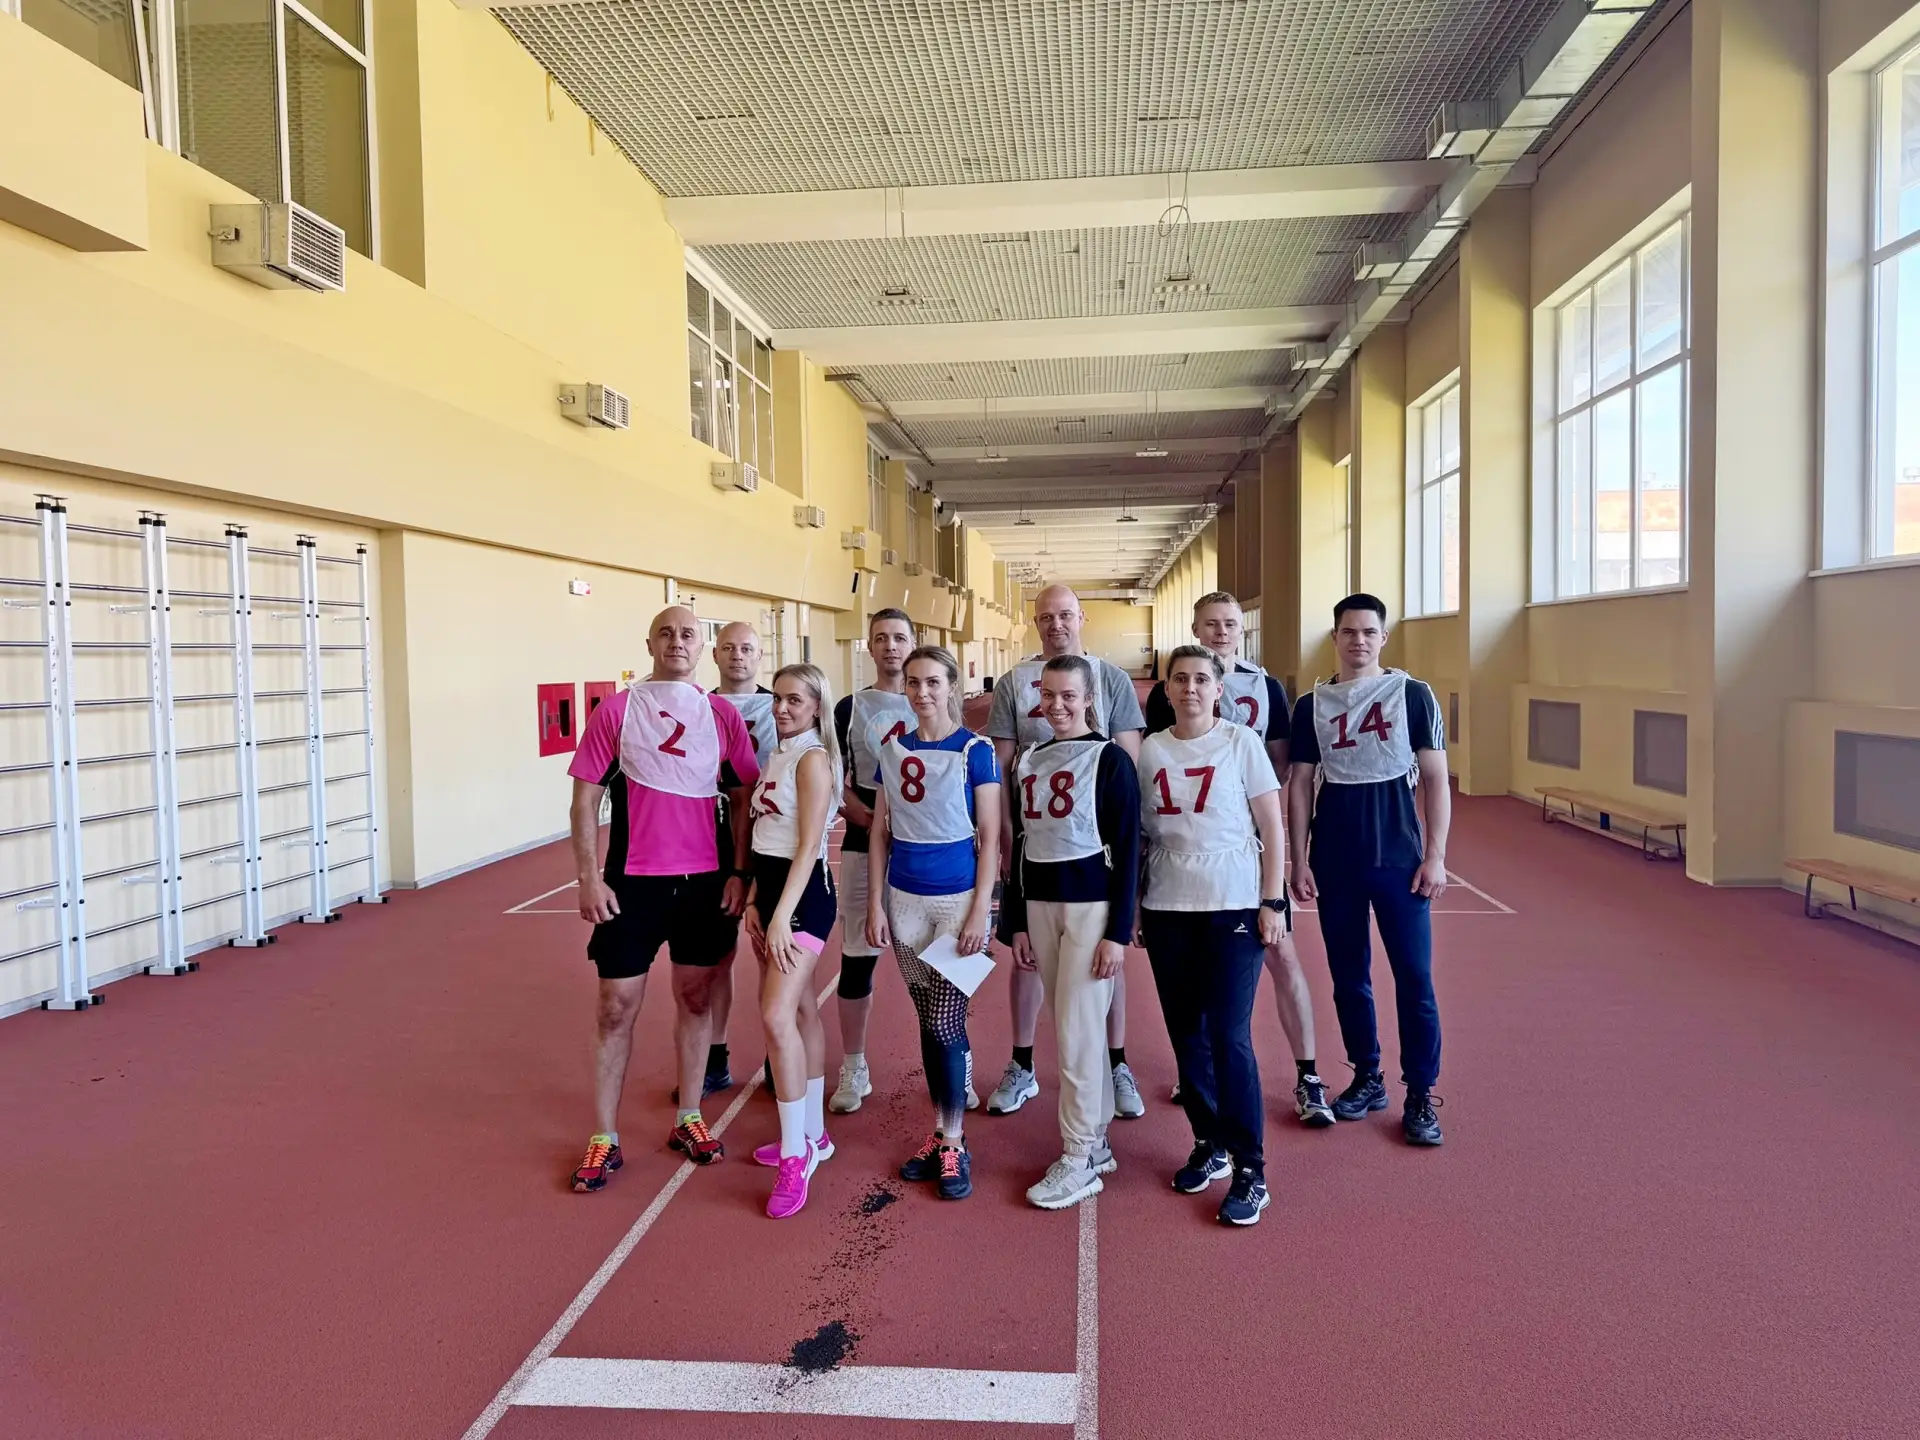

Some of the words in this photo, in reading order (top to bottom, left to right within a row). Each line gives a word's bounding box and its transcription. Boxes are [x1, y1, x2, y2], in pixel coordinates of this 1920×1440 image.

[658, 711, 686, 758] 2
[1329, 702, 1392, 750] 14
[901, 756, 925, 803] 8
[1021, 771, 1074, 819] 18
[1153, 766, 1215, 815] 17
